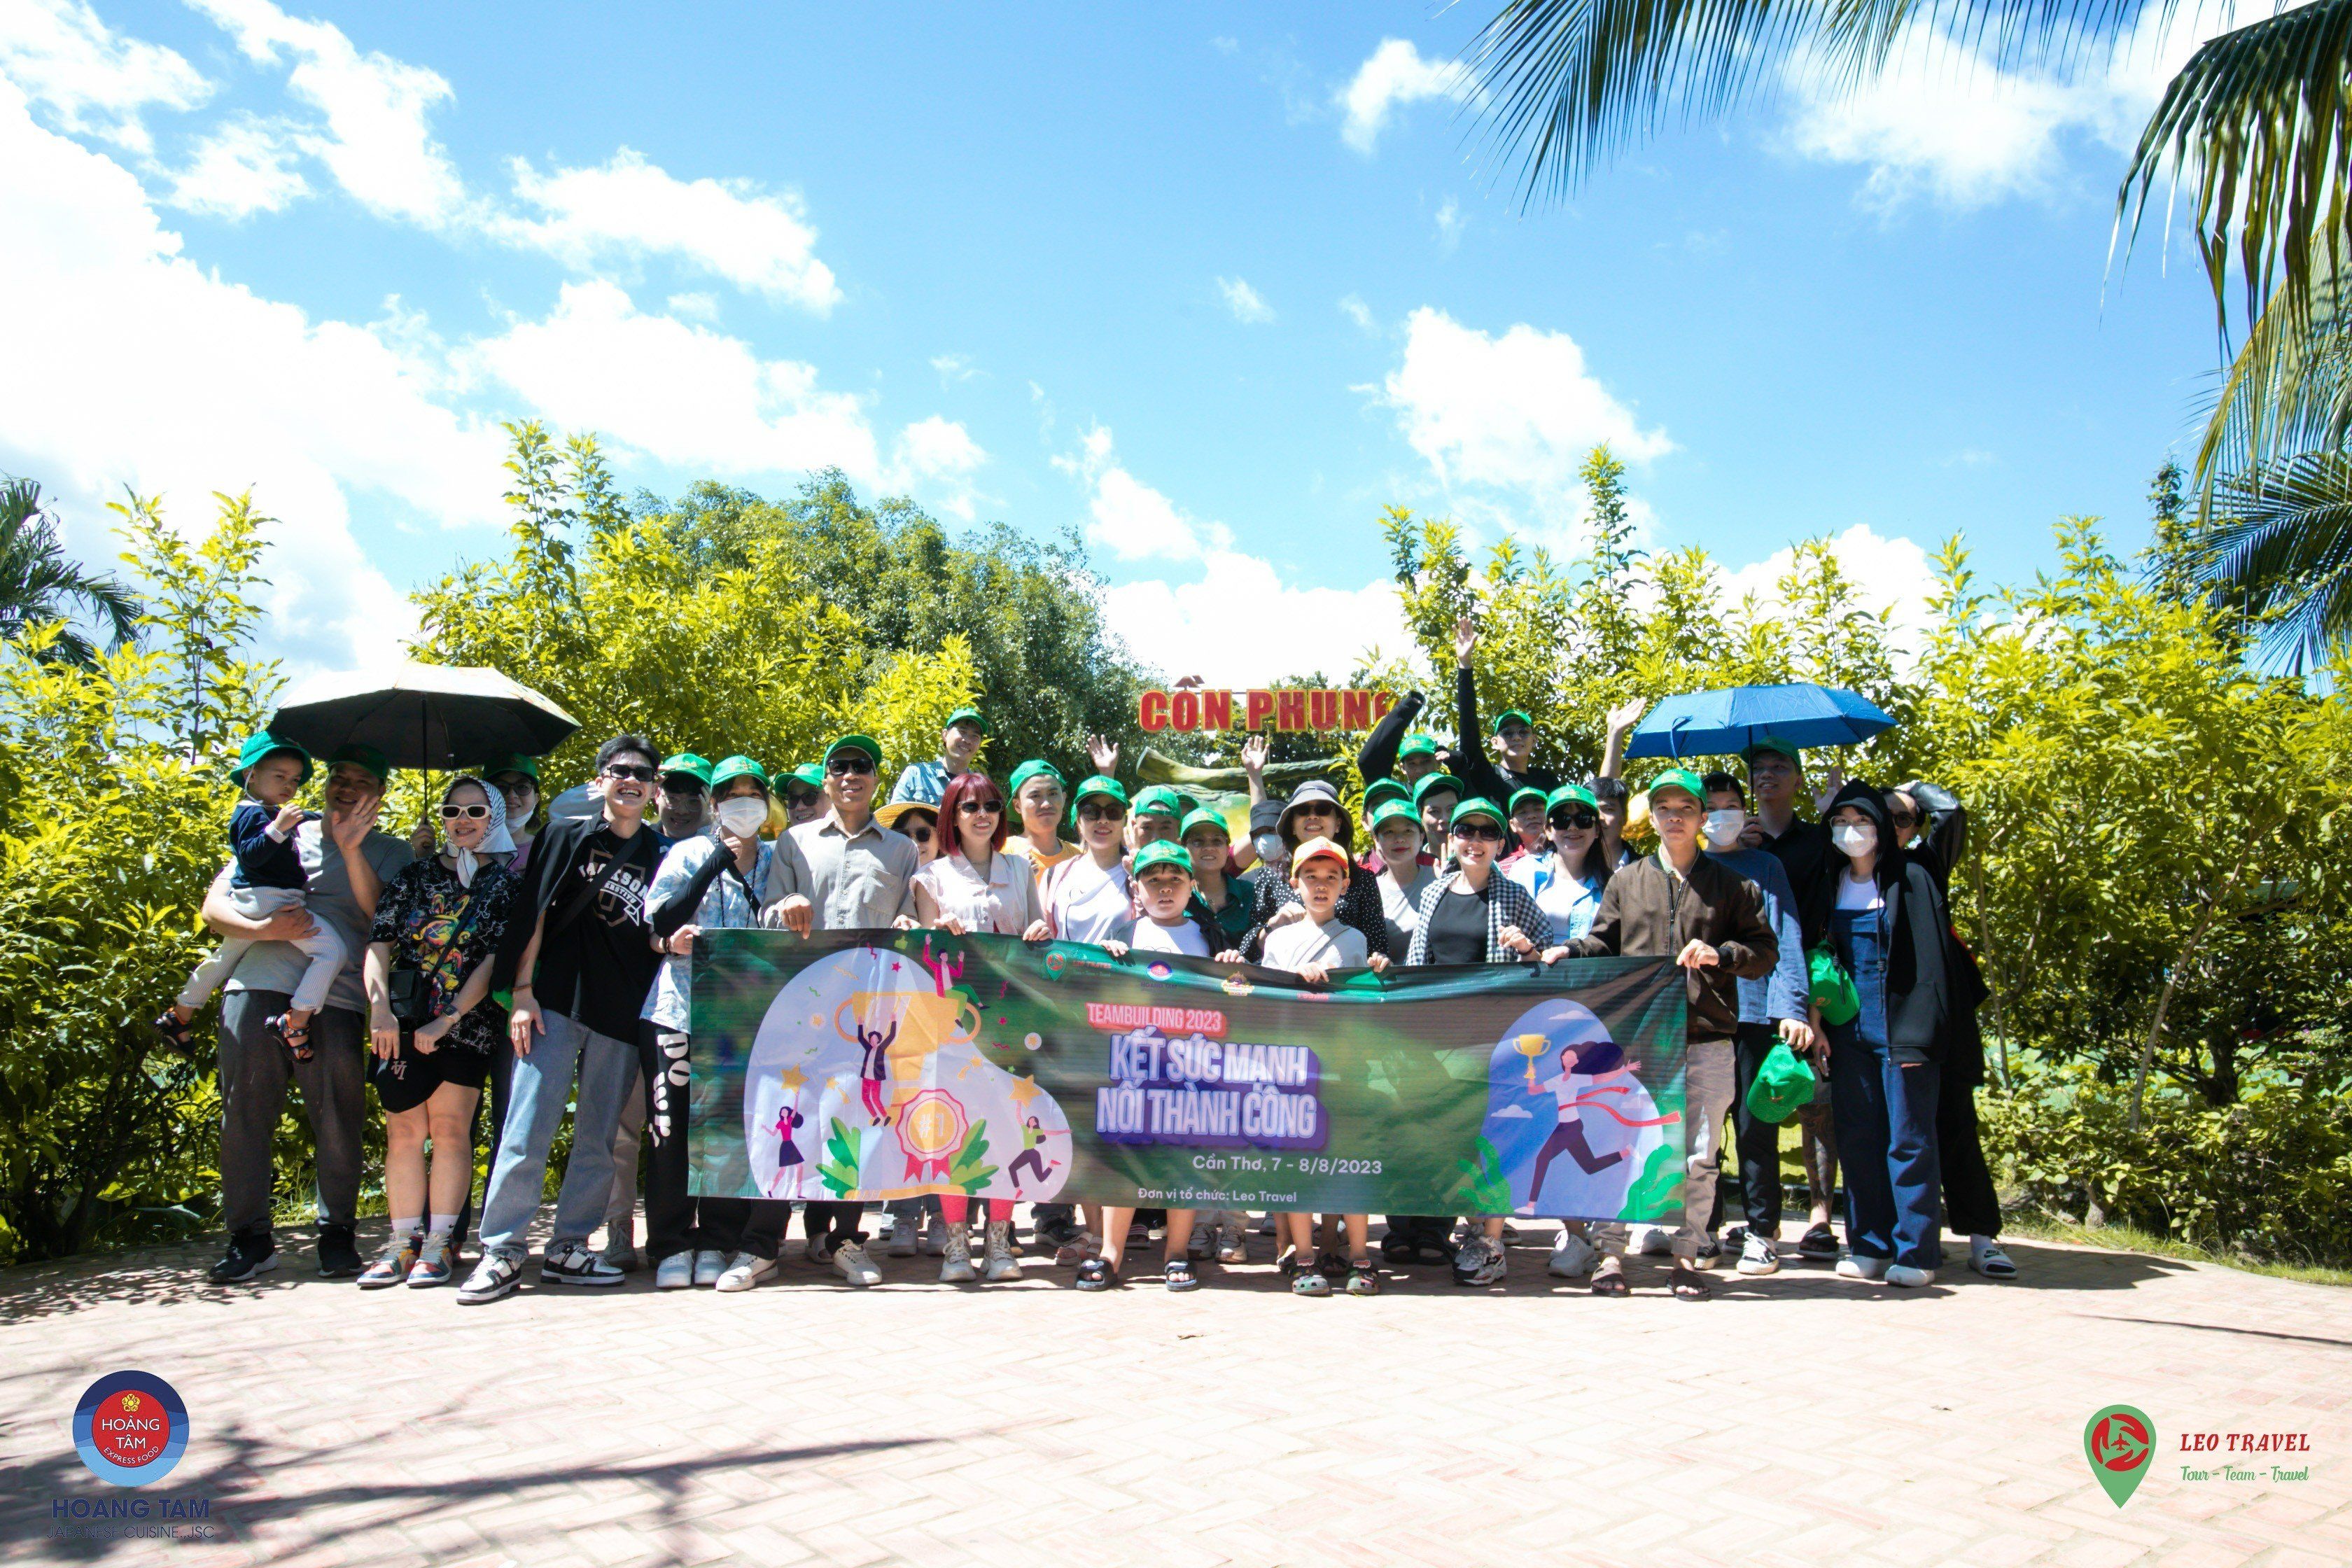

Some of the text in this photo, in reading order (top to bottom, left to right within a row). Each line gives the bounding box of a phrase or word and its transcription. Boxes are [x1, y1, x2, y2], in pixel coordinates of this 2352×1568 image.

[1087, 1003, 1223, 1032] TEAMBUILDING 2023
[1110, 1026, 1166, 1081] KẾT
[1224, 1042, 1308, 1092] MẠNH
[1097, 1079, 1317, 1138] NỐI THÀNH CÔNG
[919, 1114, 944, 1138] #1
[1192, 1153, 1226, 1170] Cần
[1231, 1156, 1266, 1172] Thơ,
[1271, 1158, 1281, 1170] 7
[1299, 1157, 1382, 1175] 8/8/2023
[1138, 1186, 1297, 1203] Đơn vị tổ chức: Leo Travel
